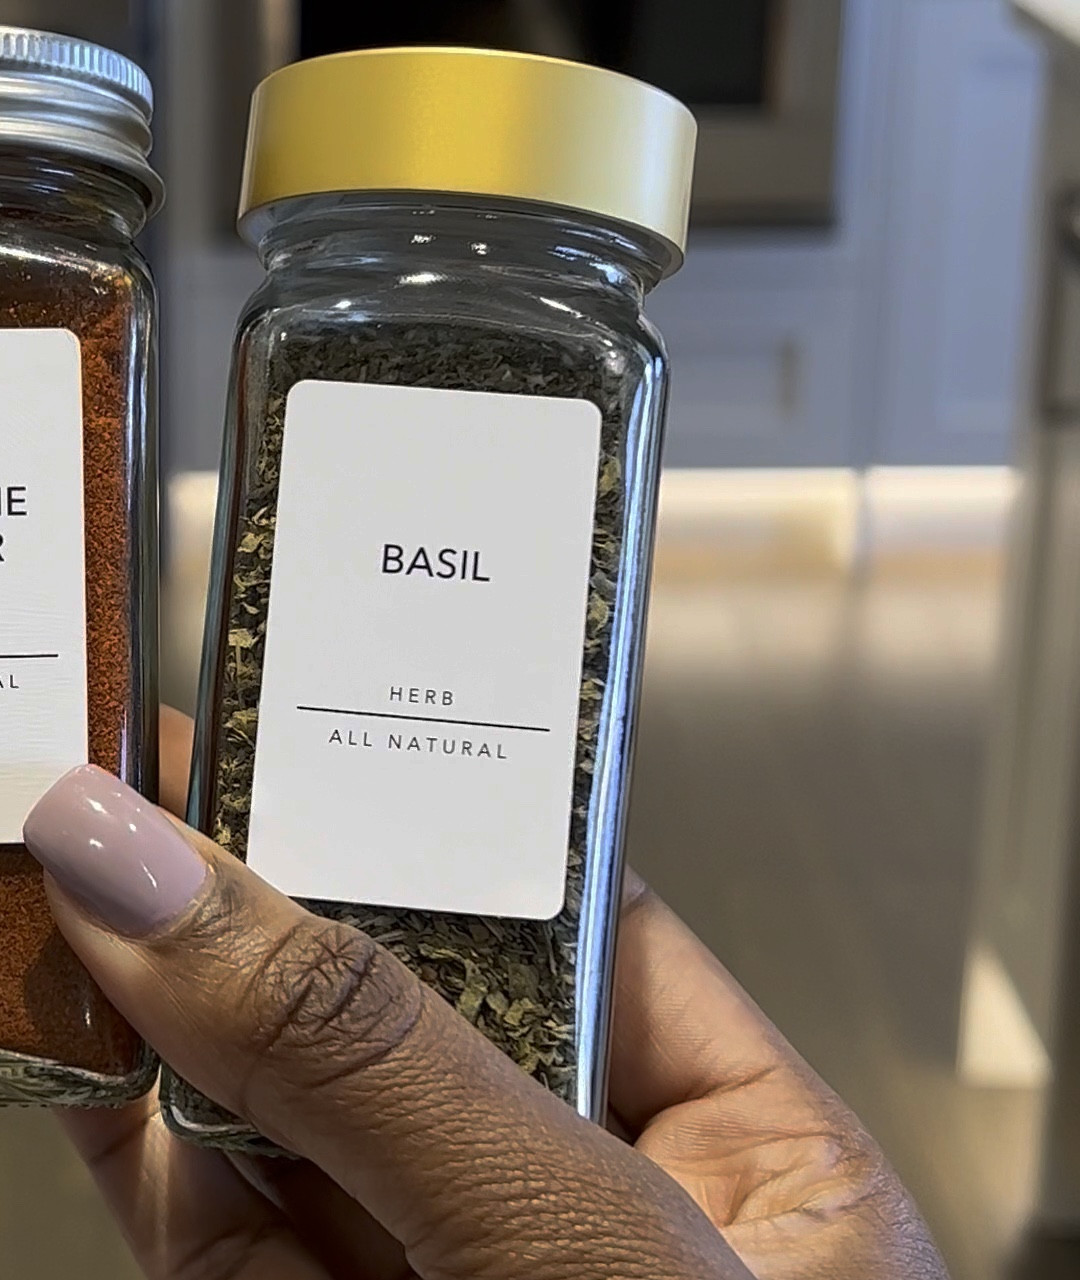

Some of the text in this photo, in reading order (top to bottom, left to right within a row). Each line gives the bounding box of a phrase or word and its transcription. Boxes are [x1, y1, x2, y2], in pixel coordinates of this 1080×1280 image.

[381, 543, 490, 582] BASIL
[389, 686, 453, 706] HERB
[328, 729, 507, 760] ALL NATURAL
